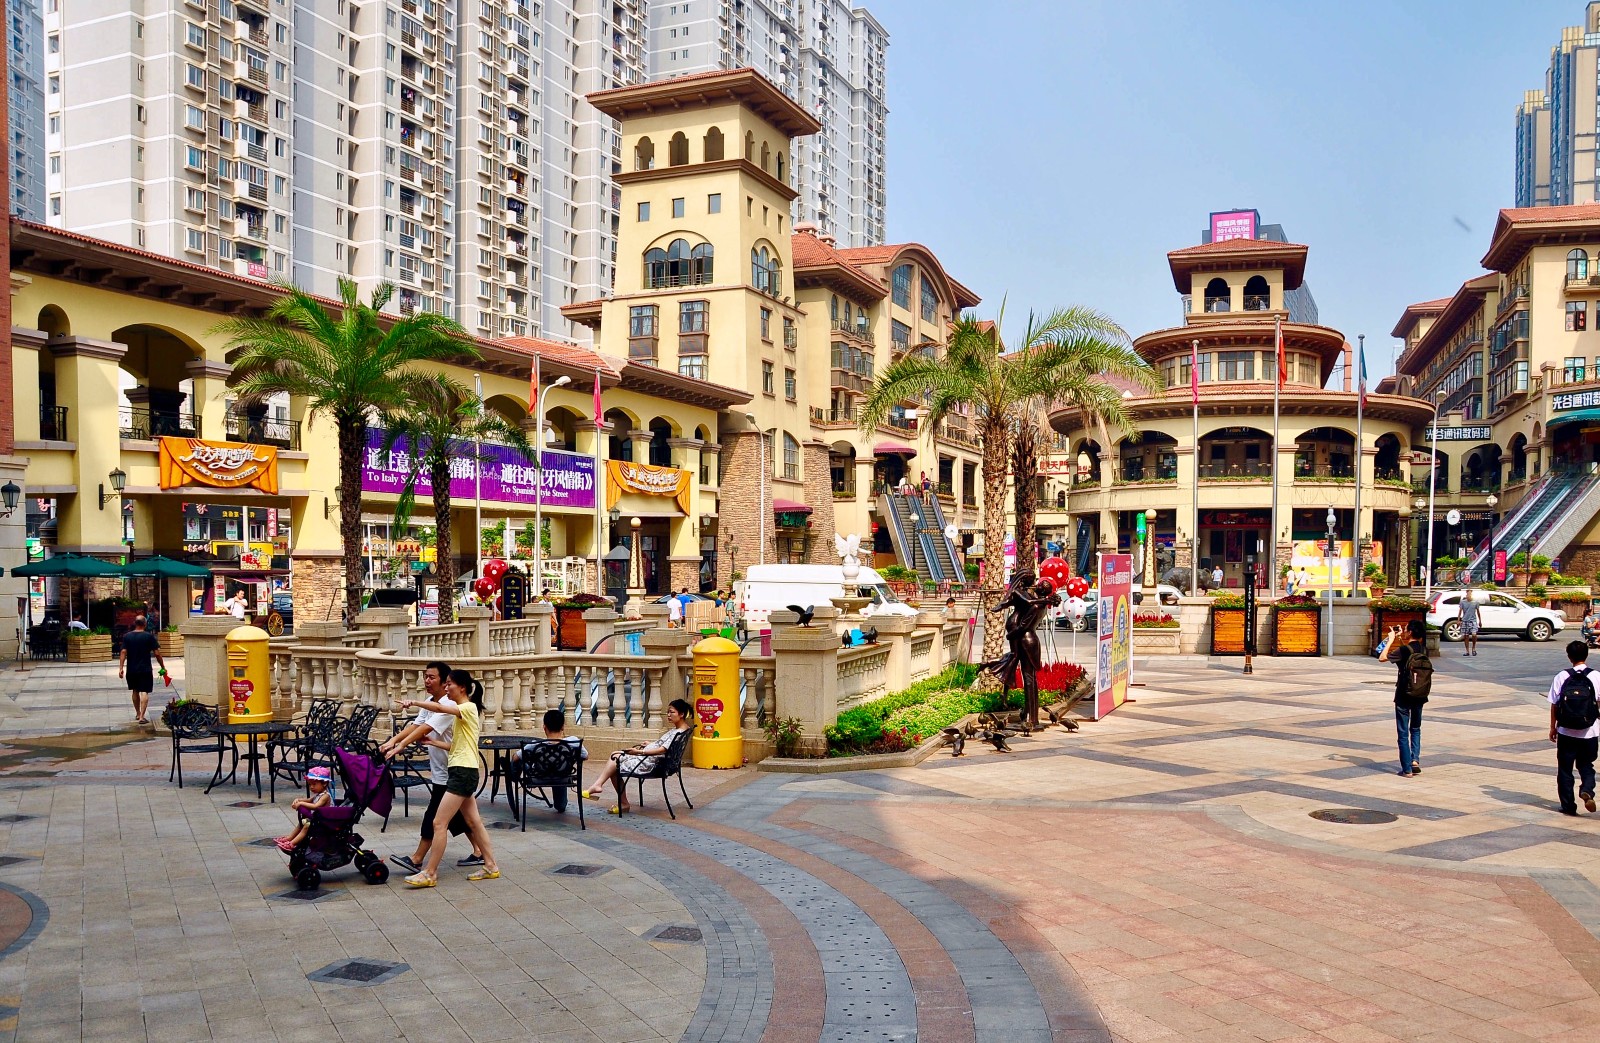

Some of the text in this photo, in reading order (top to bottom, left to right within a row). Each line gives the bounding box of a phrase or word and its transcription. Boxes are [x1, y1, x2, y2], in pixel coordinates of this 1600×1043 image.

[1426, 428, 1490, 440] 光谷通讯数码港
[367, 471, 379, 481] To
[382, 473, 398, 485] Italy
[501, 484, 568, 498] To Spanish tyle Street
